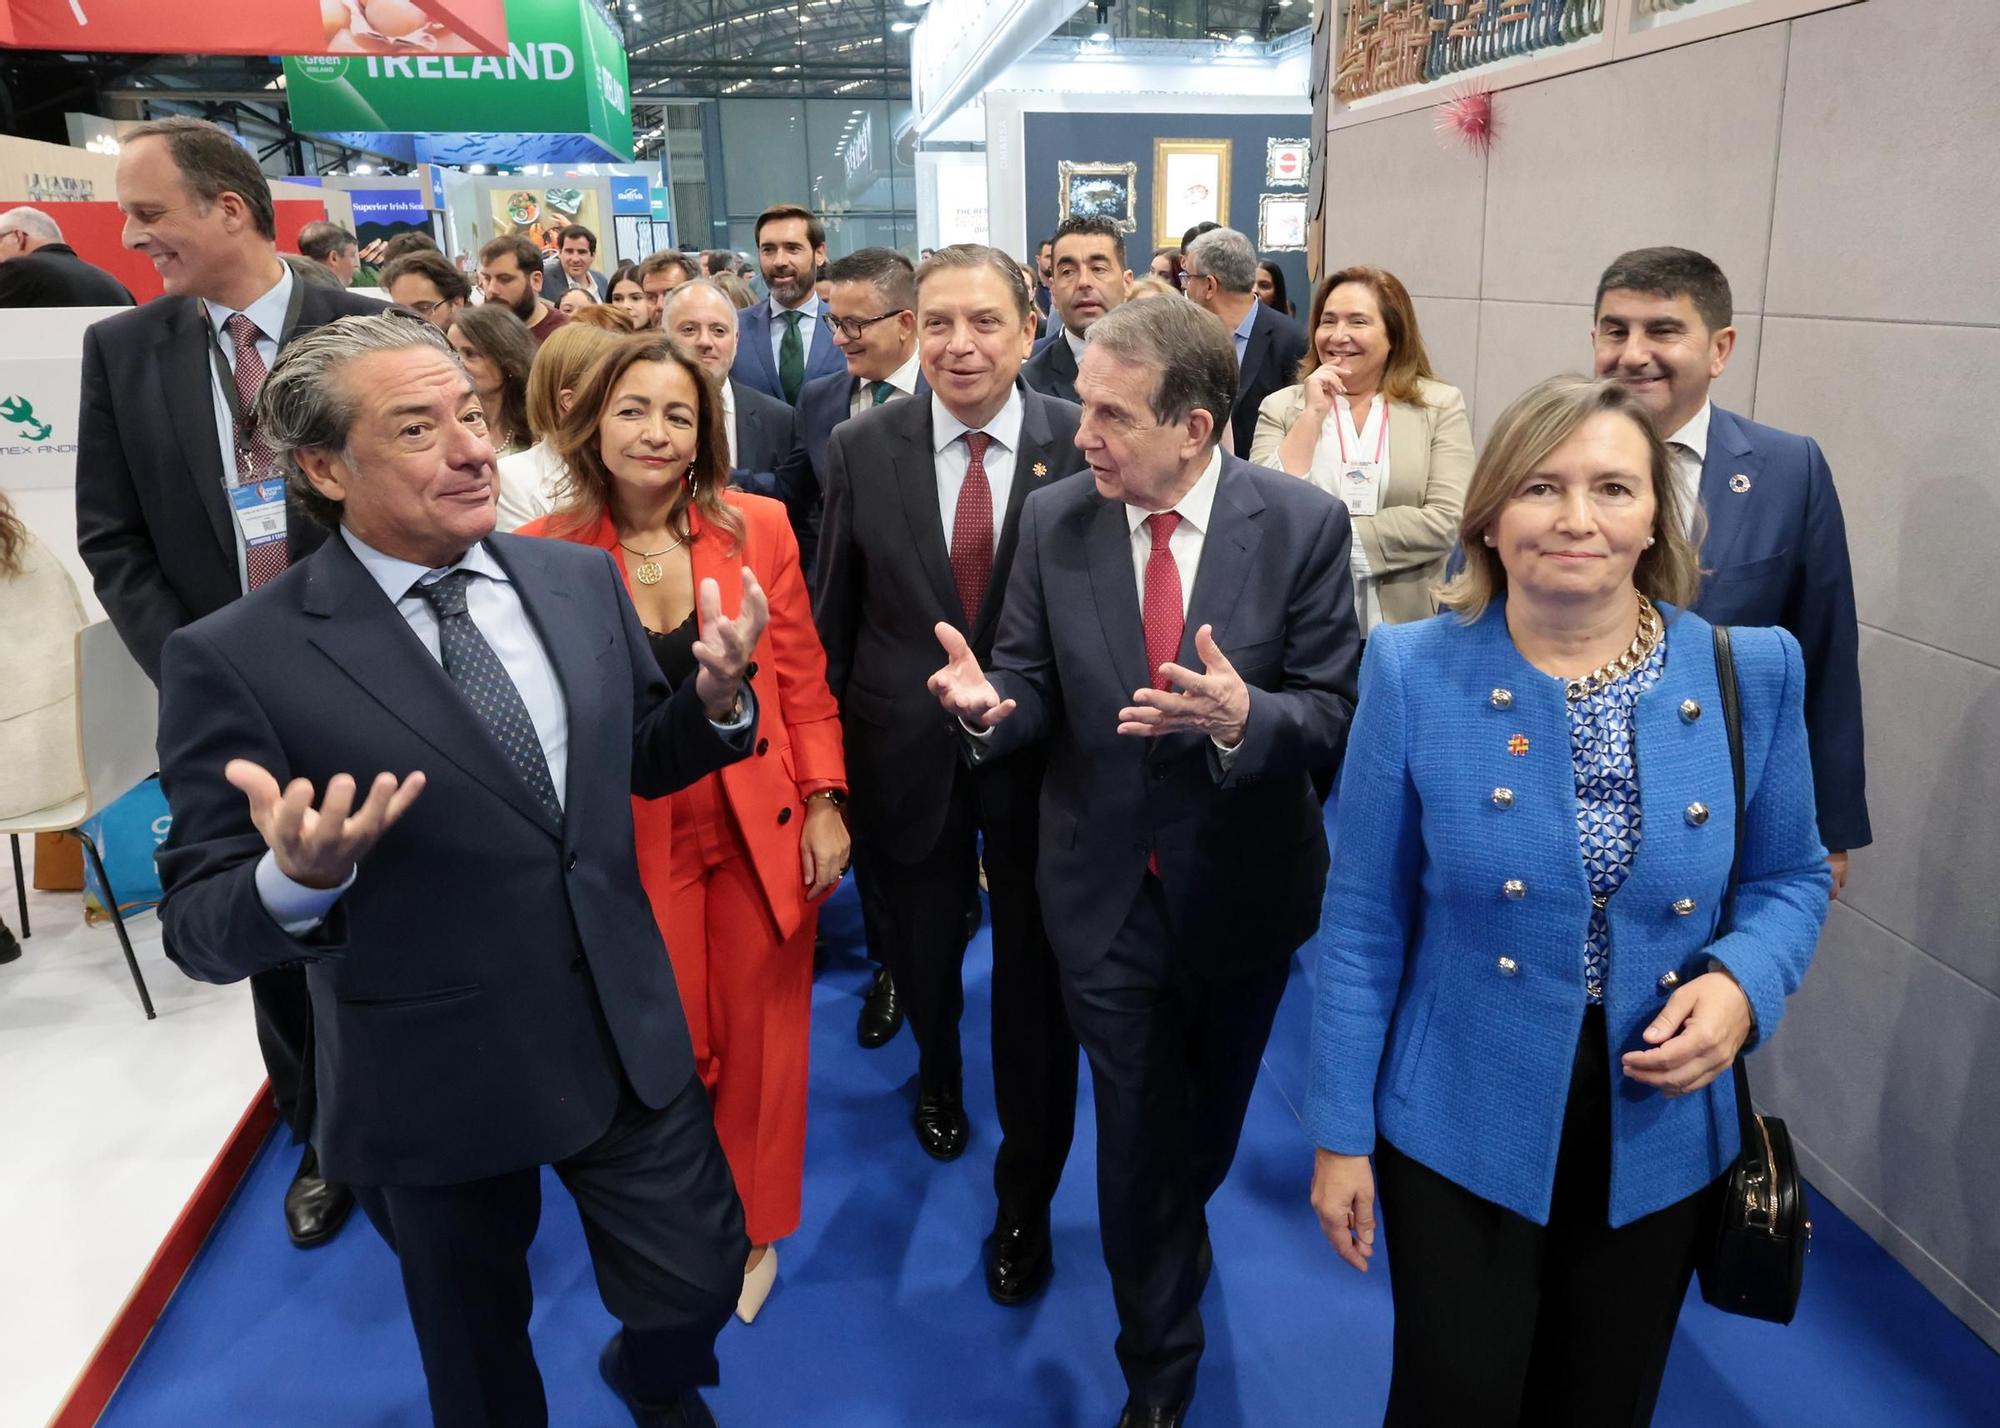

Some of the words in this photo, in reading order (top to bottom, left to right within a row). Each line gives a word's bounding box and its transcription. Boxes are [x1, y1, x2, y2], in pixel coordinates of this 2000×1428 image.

[365, 42, 575, 81] IRELAND
[352, 202, 388, 212] Superior
[389, 201, 408, 210] Irish
